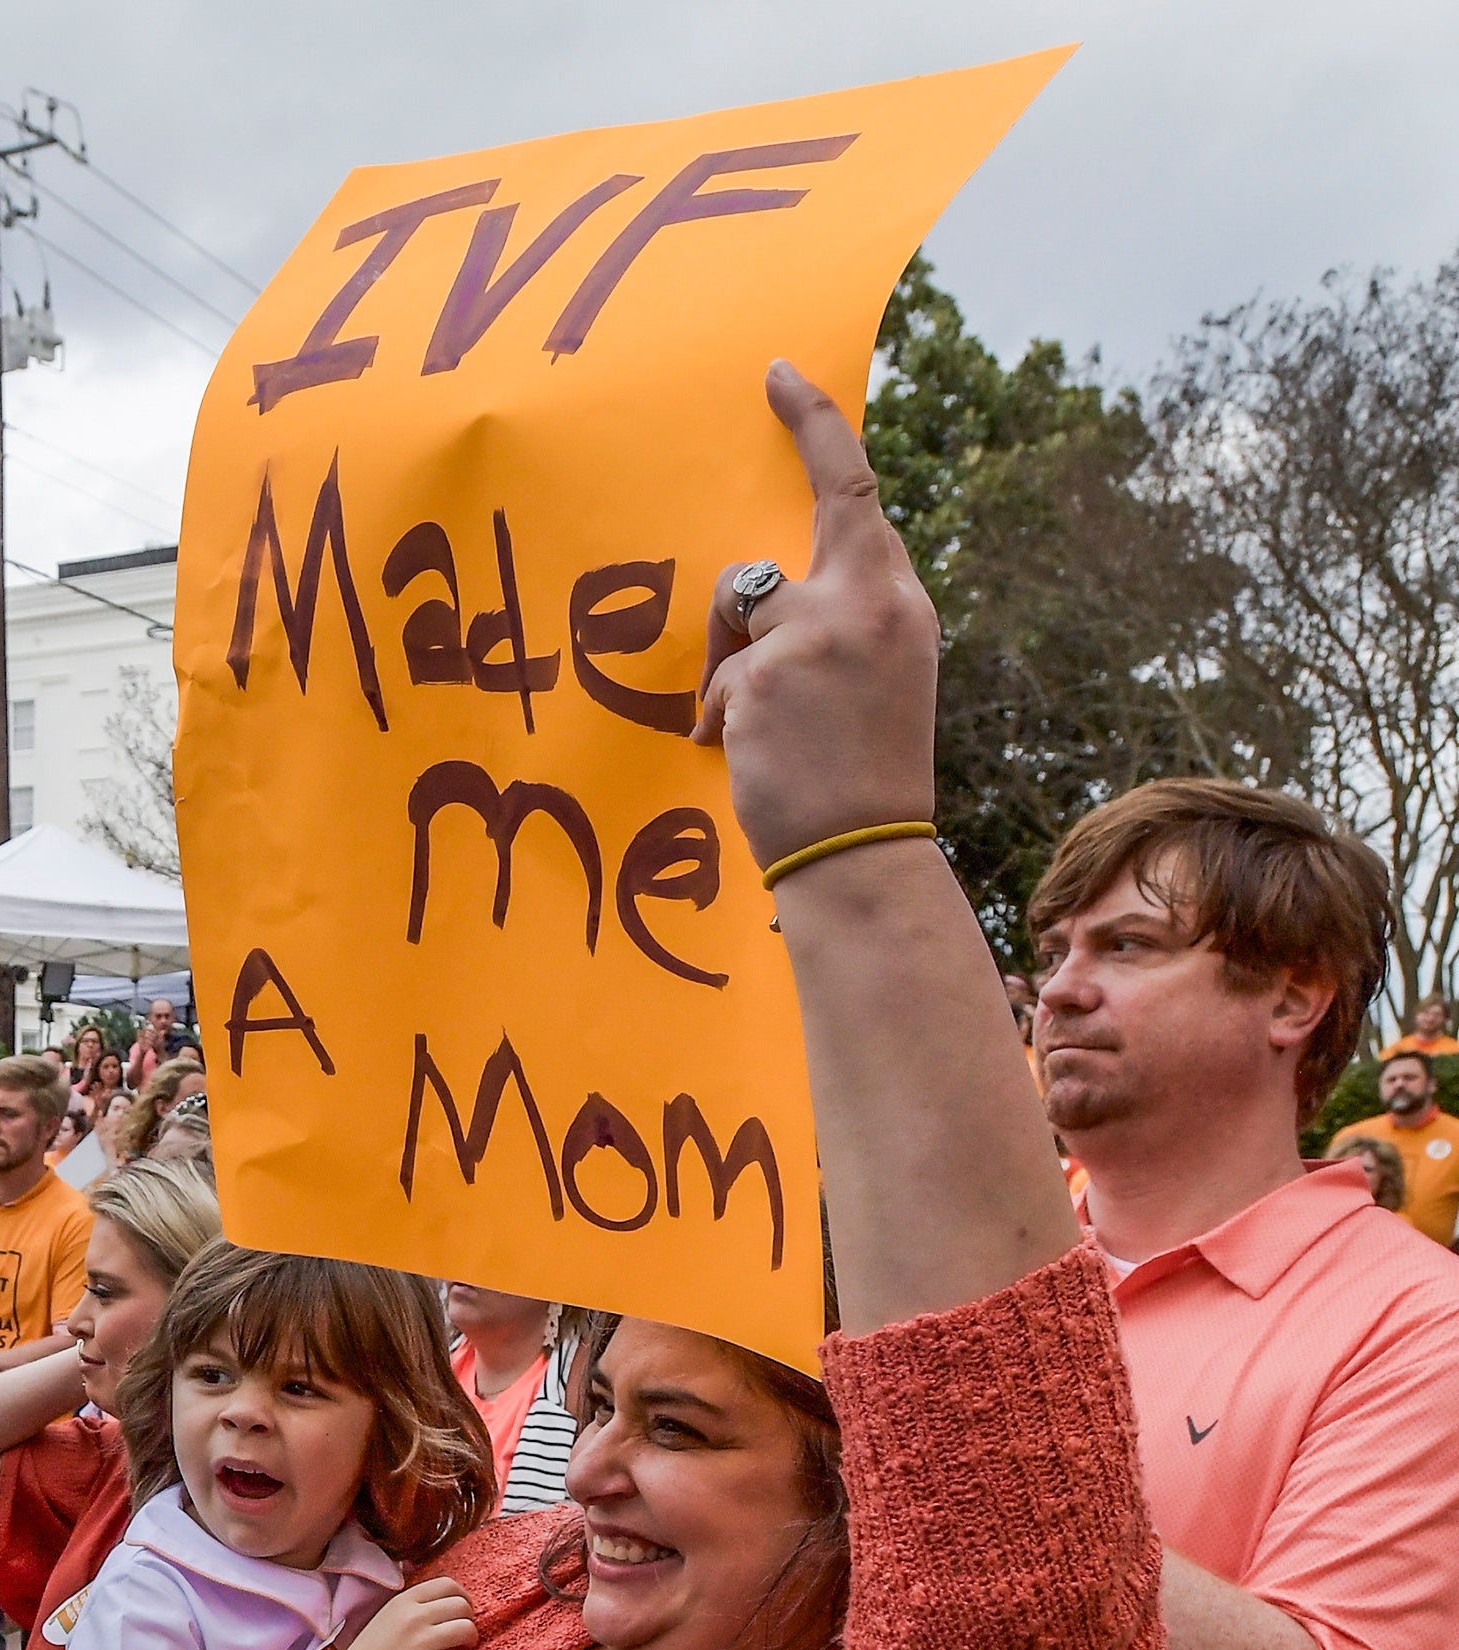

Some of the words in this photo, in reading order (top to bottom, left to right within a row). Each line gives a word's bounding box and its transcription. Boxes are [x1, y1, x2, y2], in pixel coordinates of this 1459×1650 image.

[246, 133, 861, 415] IVF
[224, 447, 697, 736] Made
[407, 760, 729, 990] me
[224, 947, 337, 1077] A
[399, 1026, 783, 1271] Mom
